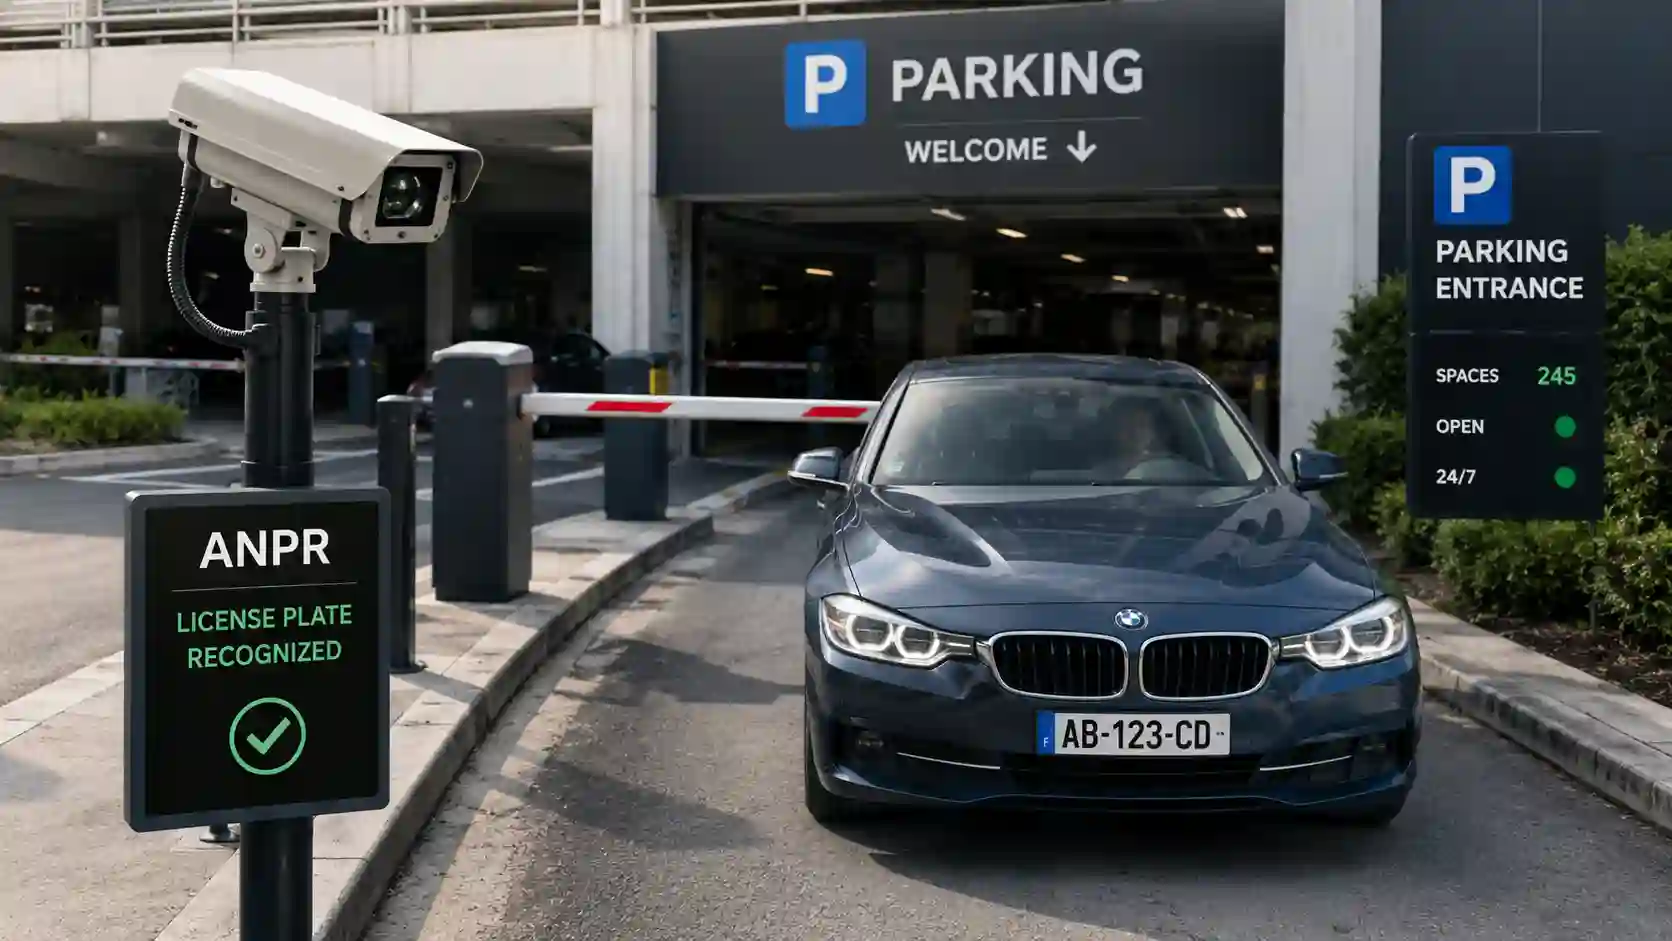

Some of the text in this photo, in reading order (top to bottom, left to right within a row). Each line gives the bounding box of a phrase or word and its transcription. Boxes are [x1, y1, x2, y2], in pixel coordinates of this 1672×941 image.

[804, 54, 847, 114] P
[892, 48, 1143, 102] PARKING
[904, 137, 1048, 163] WELCOME
[1450, 156, 1496, 213] P
[1436, 239, 1568, 263] PARKING
[1436, 276, 1584, 299] ENTRANCE
[1436, 366, 1576, 386] SPACES 245
[1436, 419, 1484, 434] OPEN
[1436, 469, 1476, 485] 24/7
[199, 528, 330, 569] ANPR
[177, 603, 353, 633] LICENSE PLATE
[188, 640, 342, 669] RECOGNIZED
[1043, 719, 1211, 750] F AB-123-CD
